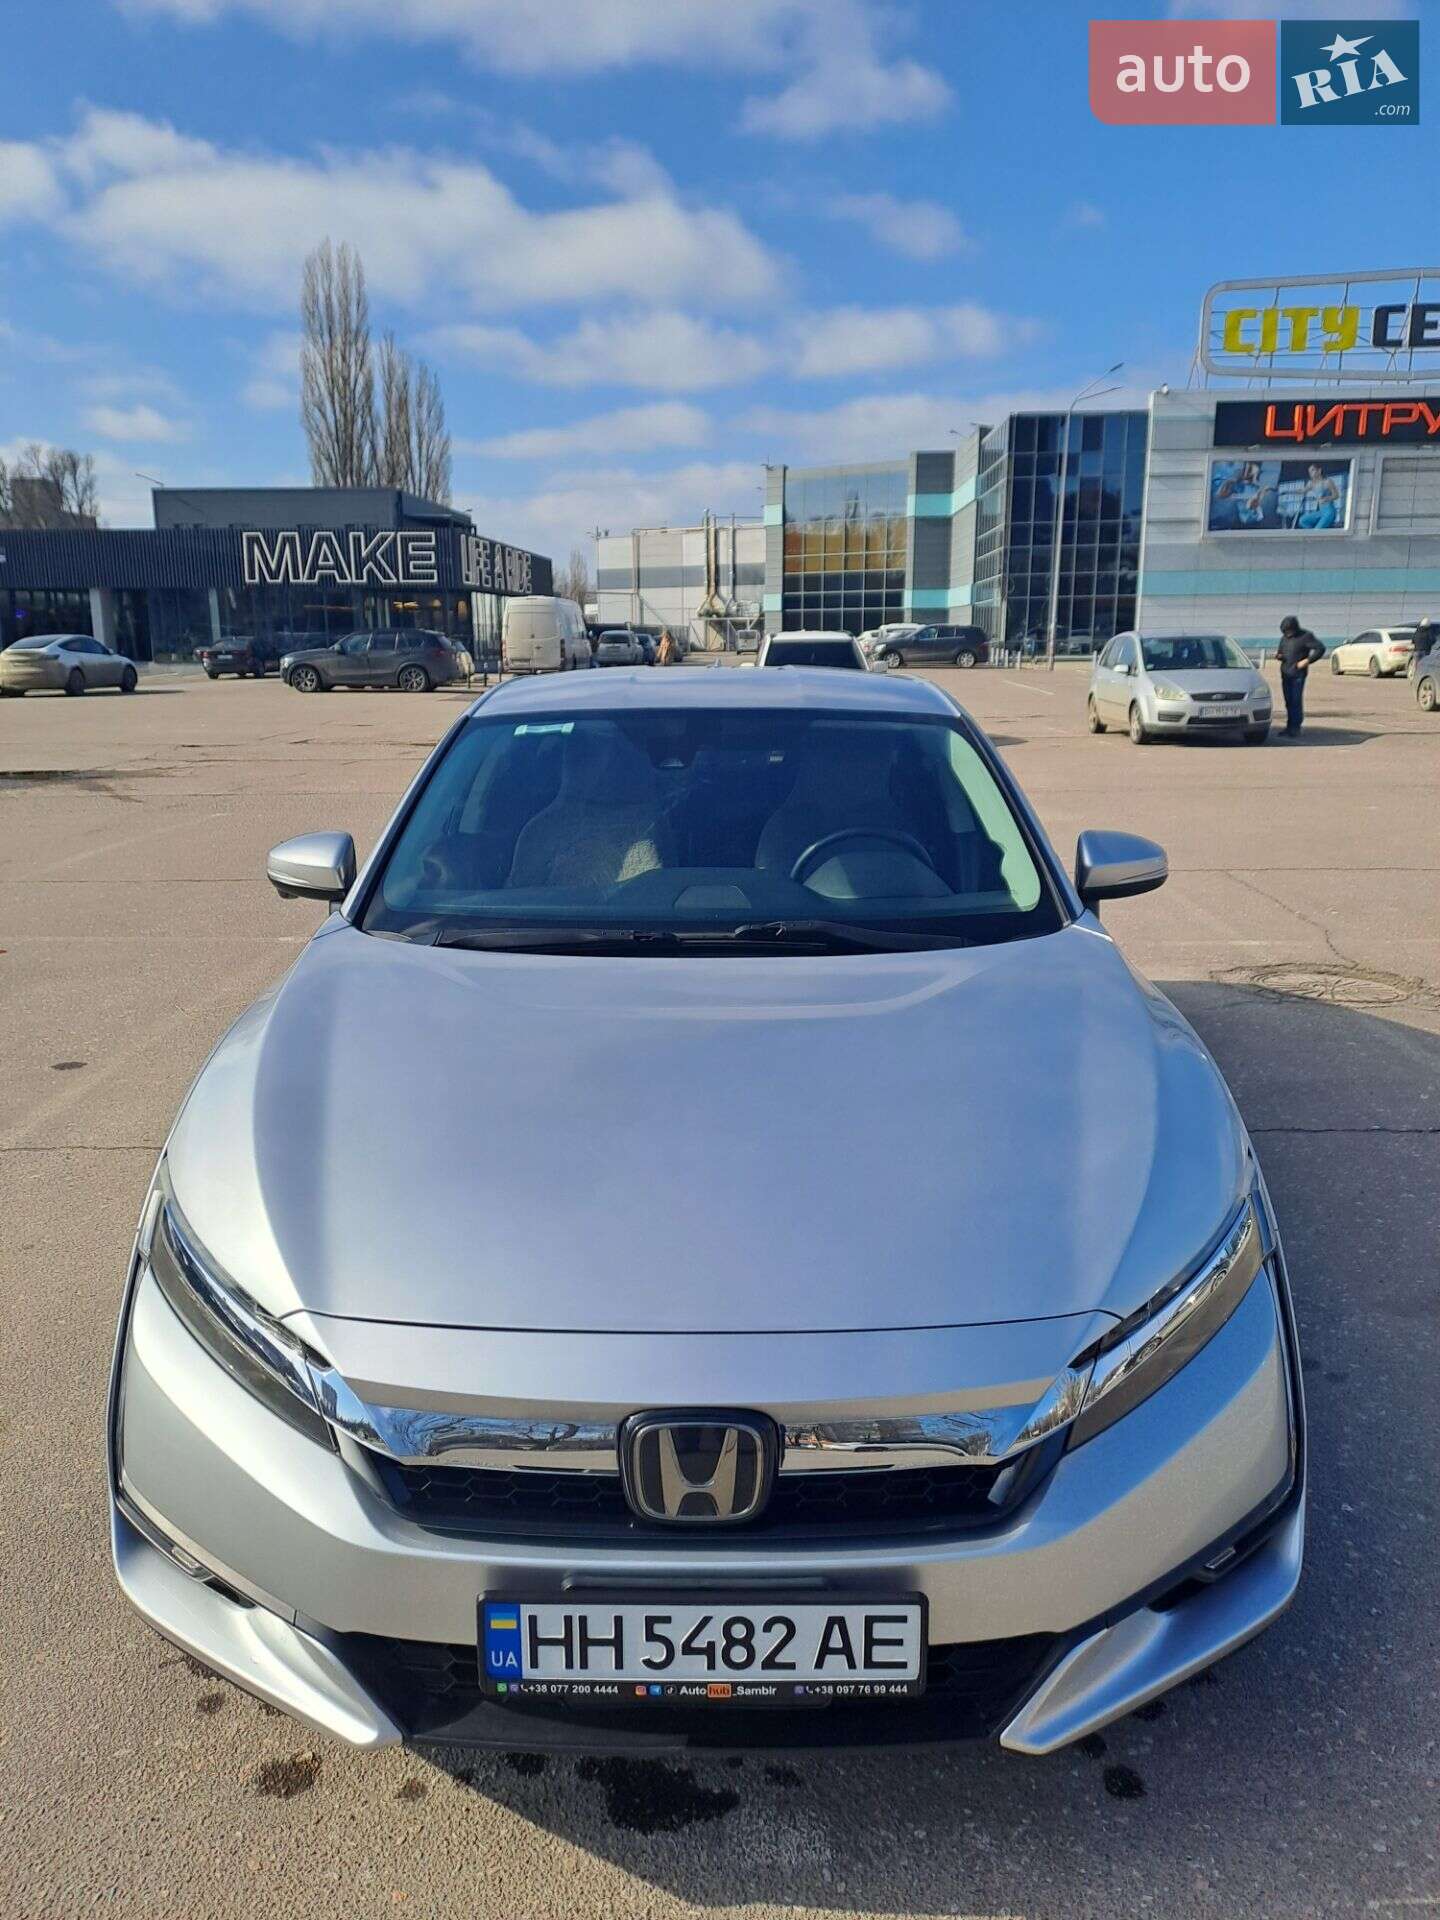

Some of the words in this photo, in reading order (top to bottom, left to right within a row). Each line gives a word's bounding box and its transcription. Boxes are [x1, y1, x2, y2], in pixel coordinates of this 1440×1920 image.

[1223, 305, 1360, 353] CITY
[242, 531, 438, 583] MAKE
[491, 1650, 519, 1668] UA
[640, 1615, 797, 1671] 5482
[813, 1615, 909, 1671] AE
[550, 1684, 569, 1694] 077
[572, 1684, 591, 1694] 200
[593, 1685, 619, 1695] 4444
[836, 1685, 855, 1695] 097
[858, 1685, 871, 1695] 76
[873, 1685, 886, 1695] 99
[888, 1684, 908, 1694] 444
